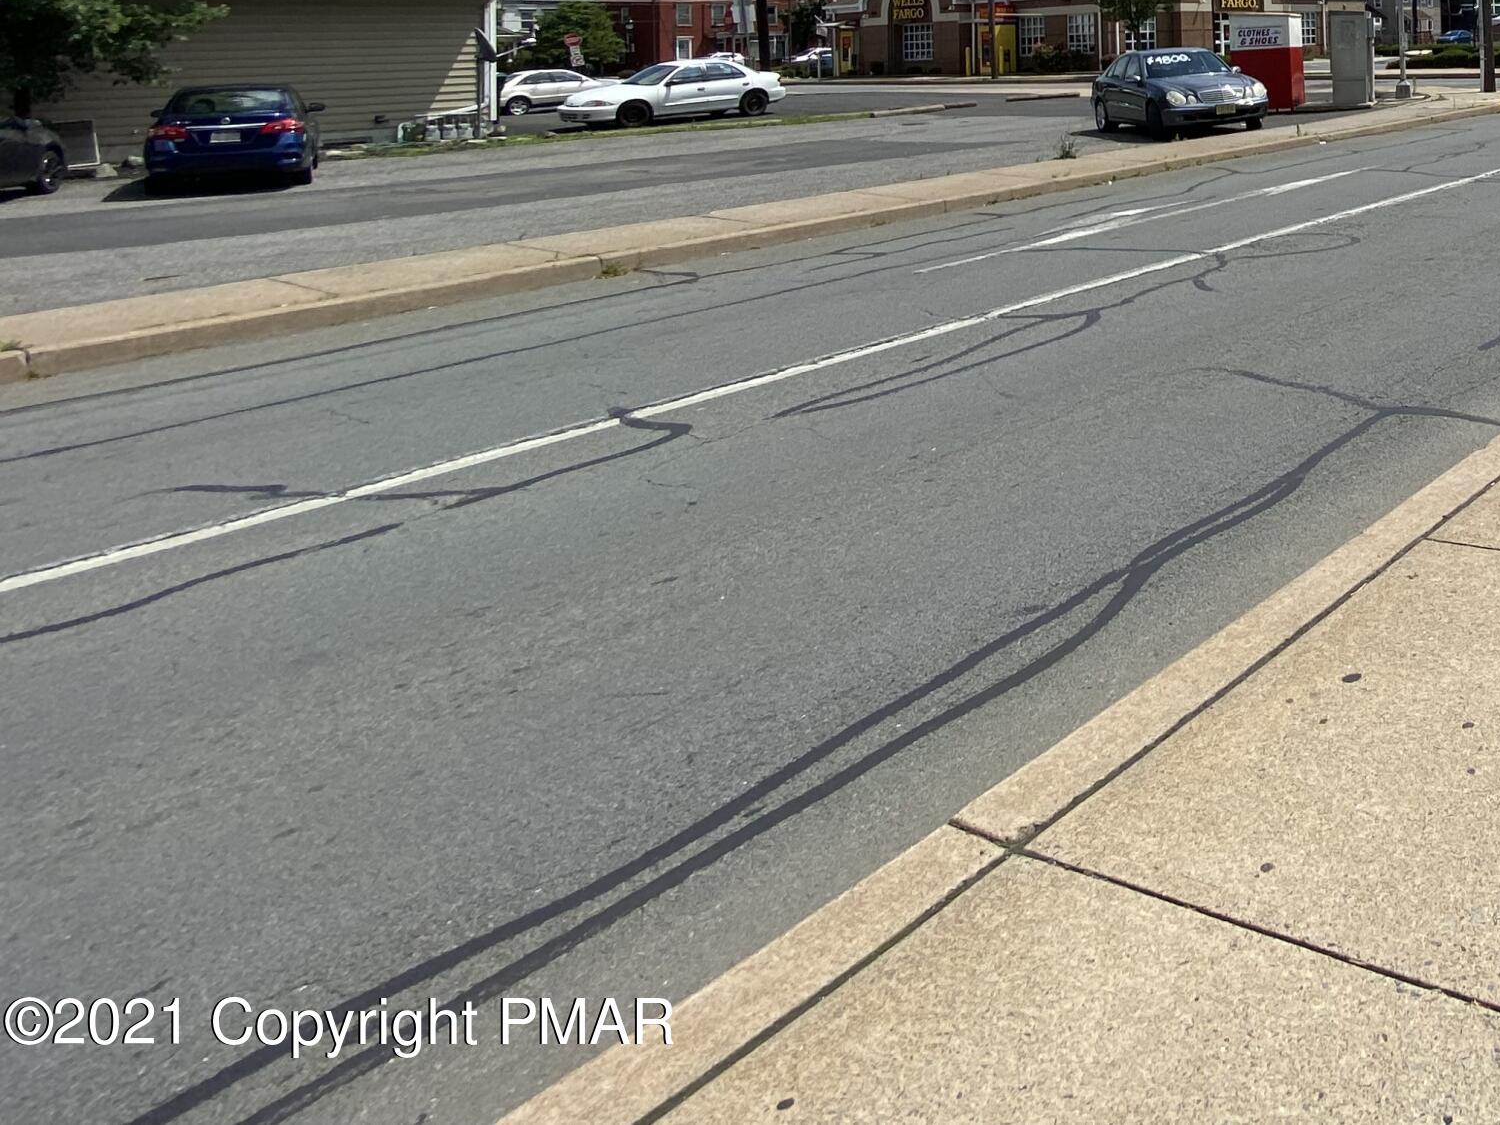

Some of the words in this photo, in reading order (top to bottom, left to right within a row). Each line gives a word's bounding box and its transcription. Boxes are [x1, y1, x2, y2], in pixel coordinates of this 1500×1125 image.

[893, 7, 924, 19] FARGO
[1238, 28, 1271, 37] CLOTHES
[1249, 36, 1279, 45] SHOES
